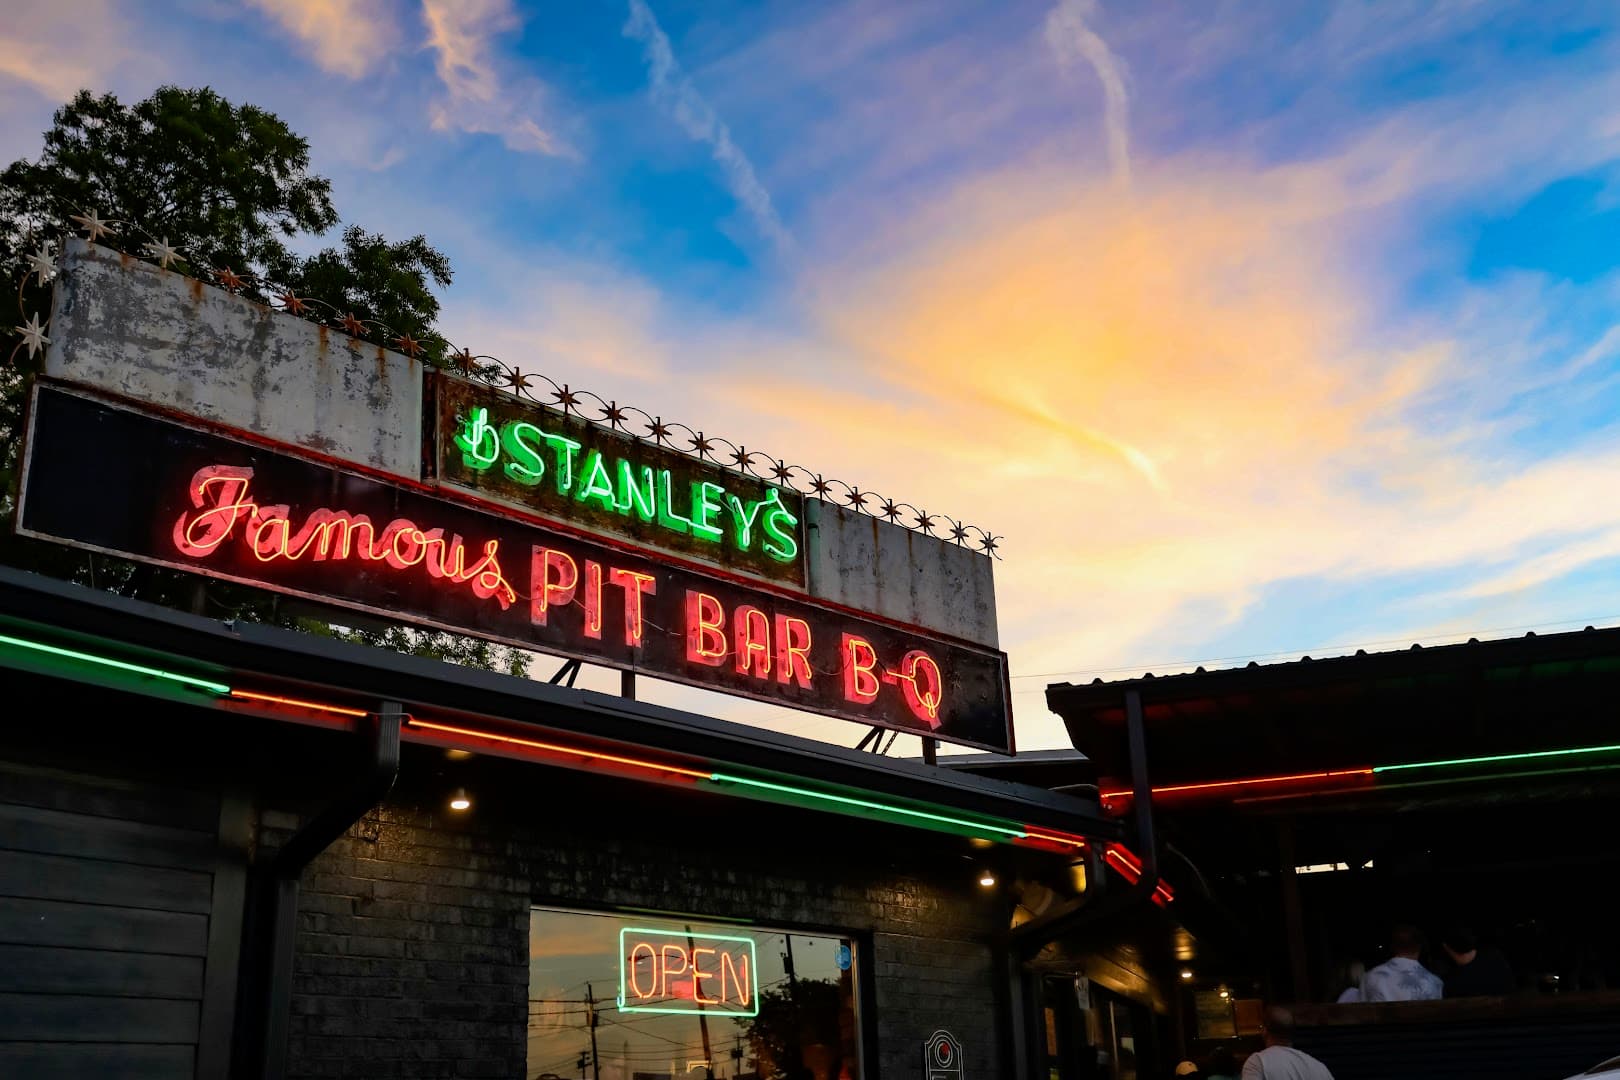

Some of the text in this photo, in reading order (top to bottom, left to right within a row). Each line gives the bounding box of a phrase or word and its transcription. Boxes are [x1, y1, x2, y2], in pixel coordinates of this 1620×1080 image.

[173, 464, 943, 730] Famous PIT BAR B-Q
[629, 943, 750, 1006] OPEN
